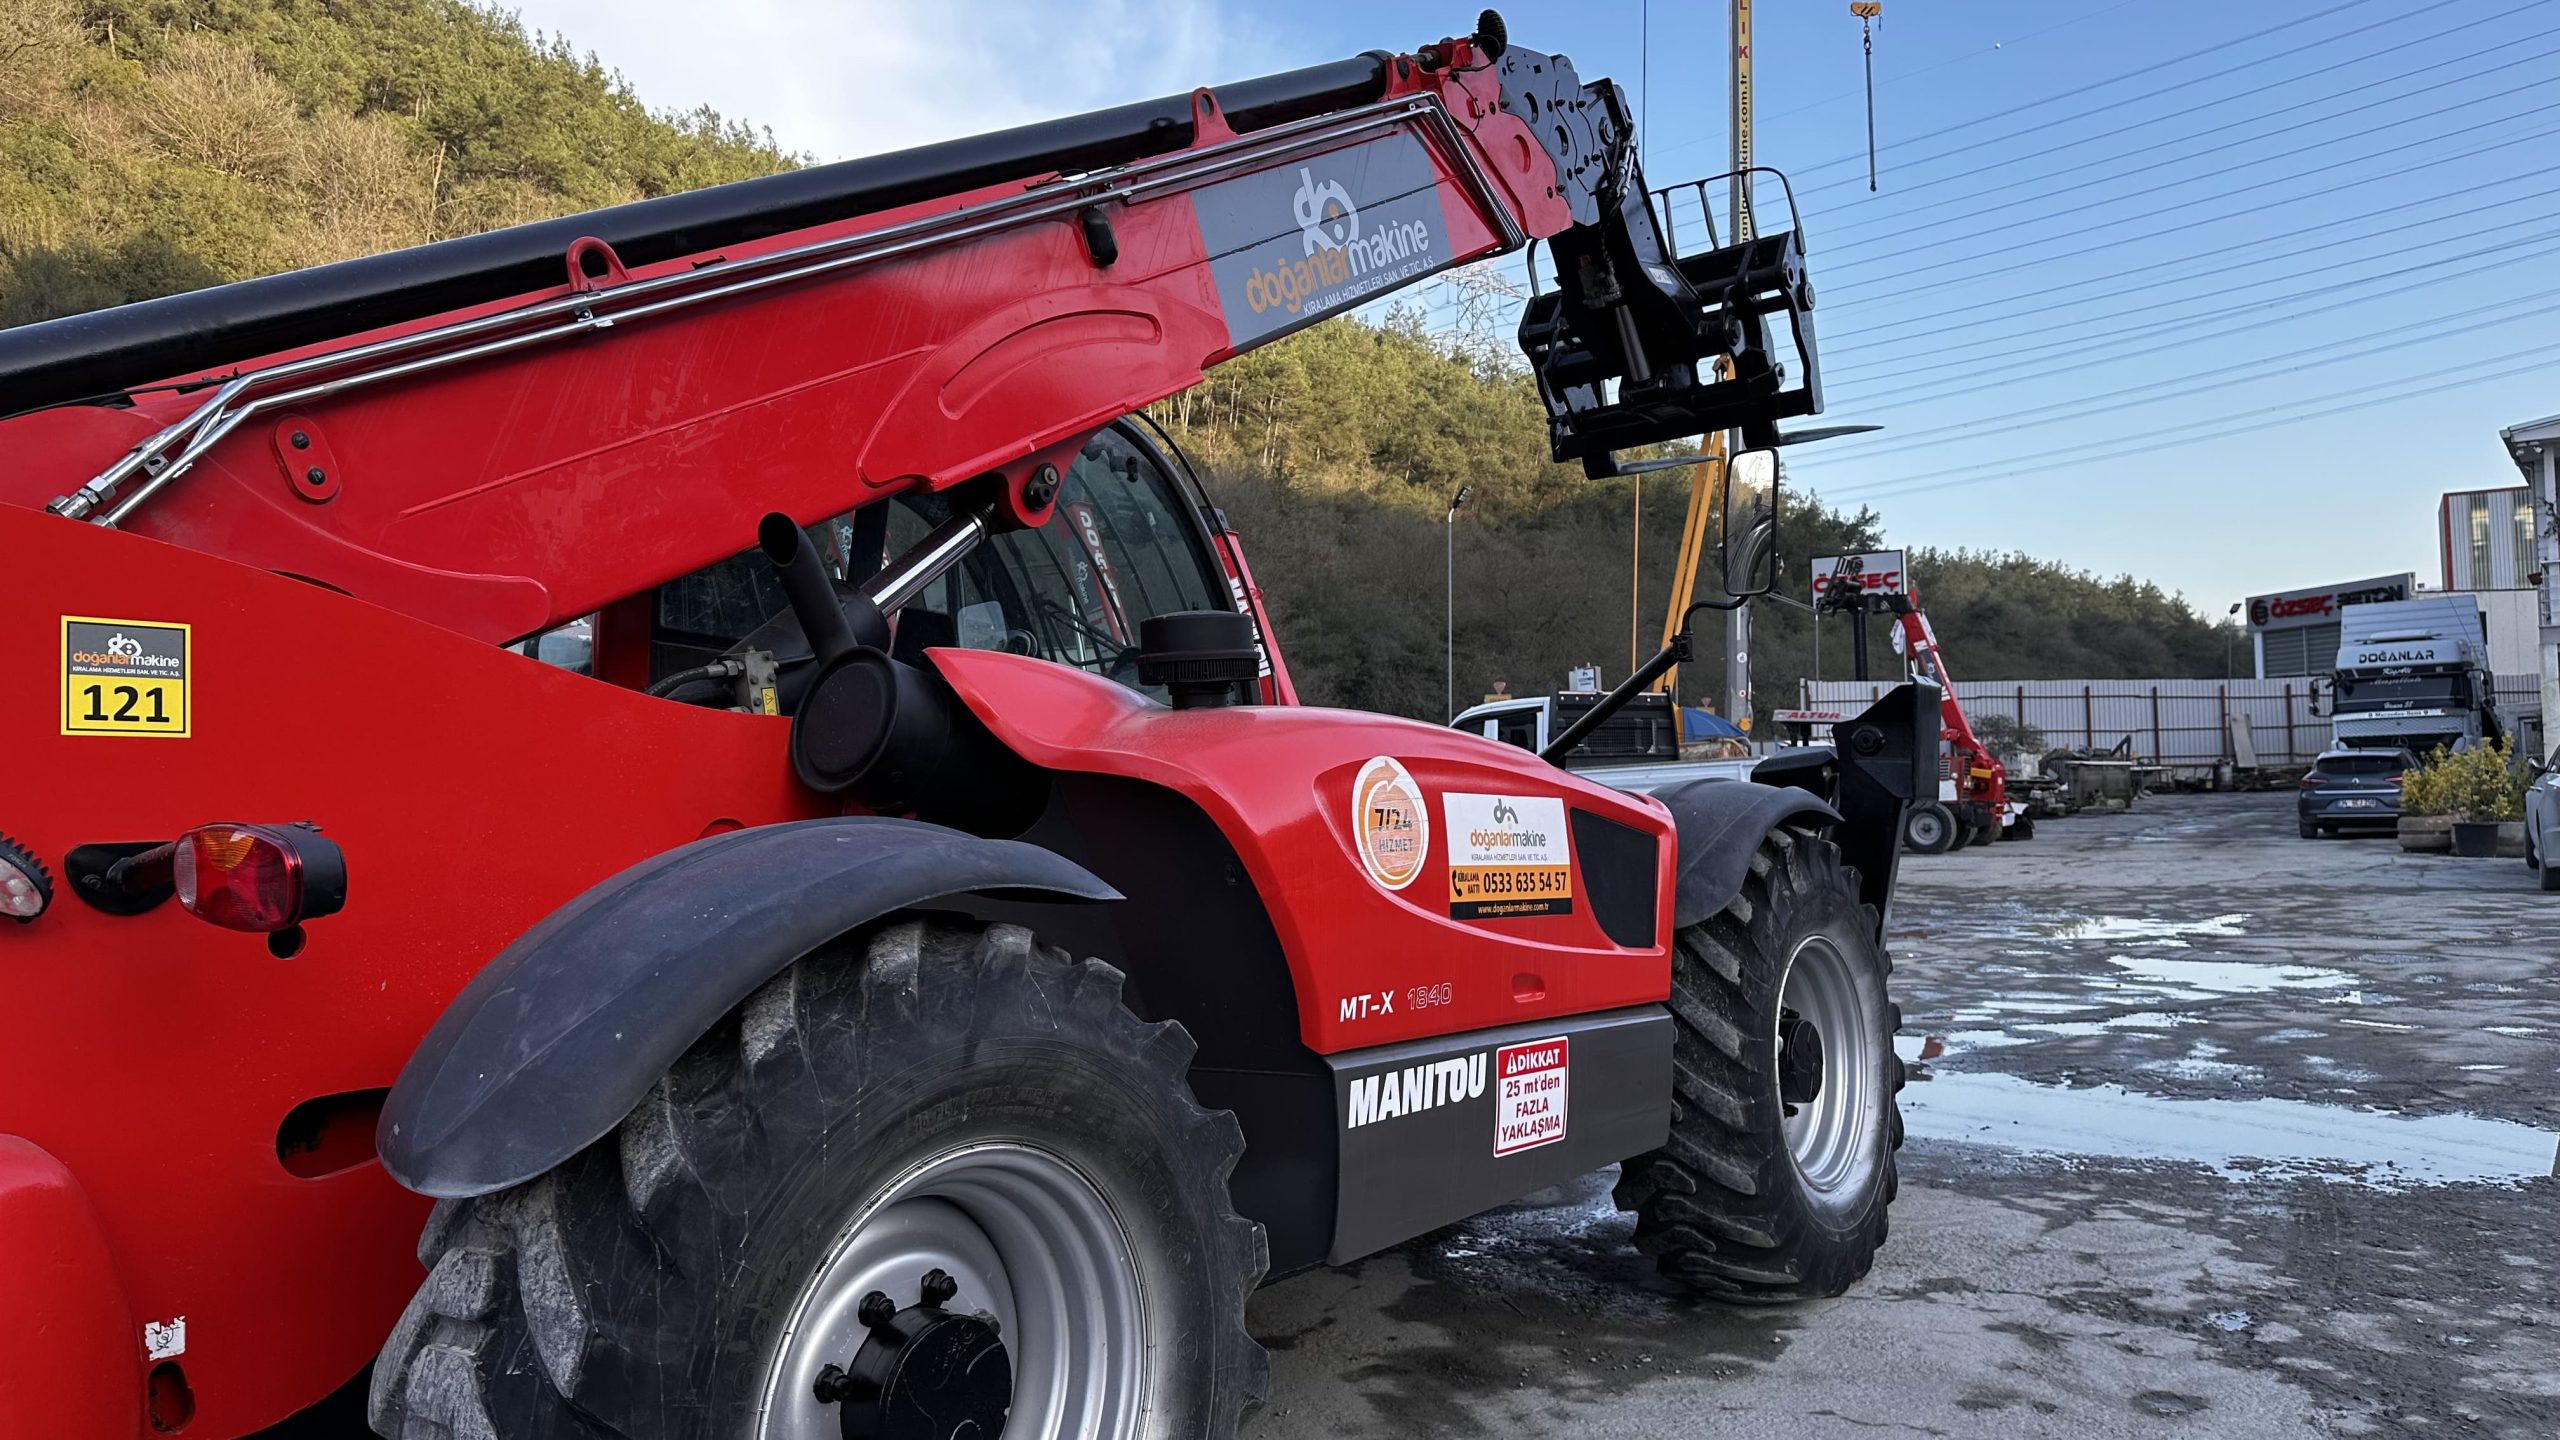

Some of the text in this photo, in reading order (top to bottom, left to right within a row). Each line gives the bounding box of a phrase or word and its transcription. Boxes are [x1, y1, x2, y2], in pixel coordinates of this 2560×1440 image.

[1342, 273, 1384, 301] HİZMETLERİ
[1400, 266, 1409, 279] VE
[1814, 571, 1900, 593] ÖSEÇ
[2271, 594, 2333, 618] ÖZSEÇ
[2359, 649, 2435, 664] DOĞANLAR
[72, 665, 102, 673] KİRALAMA
[83, 684, 170, 723] 121
[1527, 853, 1533, 861] VE
[1483, 871, 1567, 893] 0533 635 54 57
[1339, 982, 1453, 1022] MT-X 1840
[1517, 1048, 1561, 1072] DİKKAT
[1347, 1052, 1487, 1129] MANITOU
[1506, 1073, 1560, 1098] 25 mt'den
[1516, 1097, 1549, 1118] FAZLA
[1502, 1115, 1561, 1142] YAKLAŞMA
